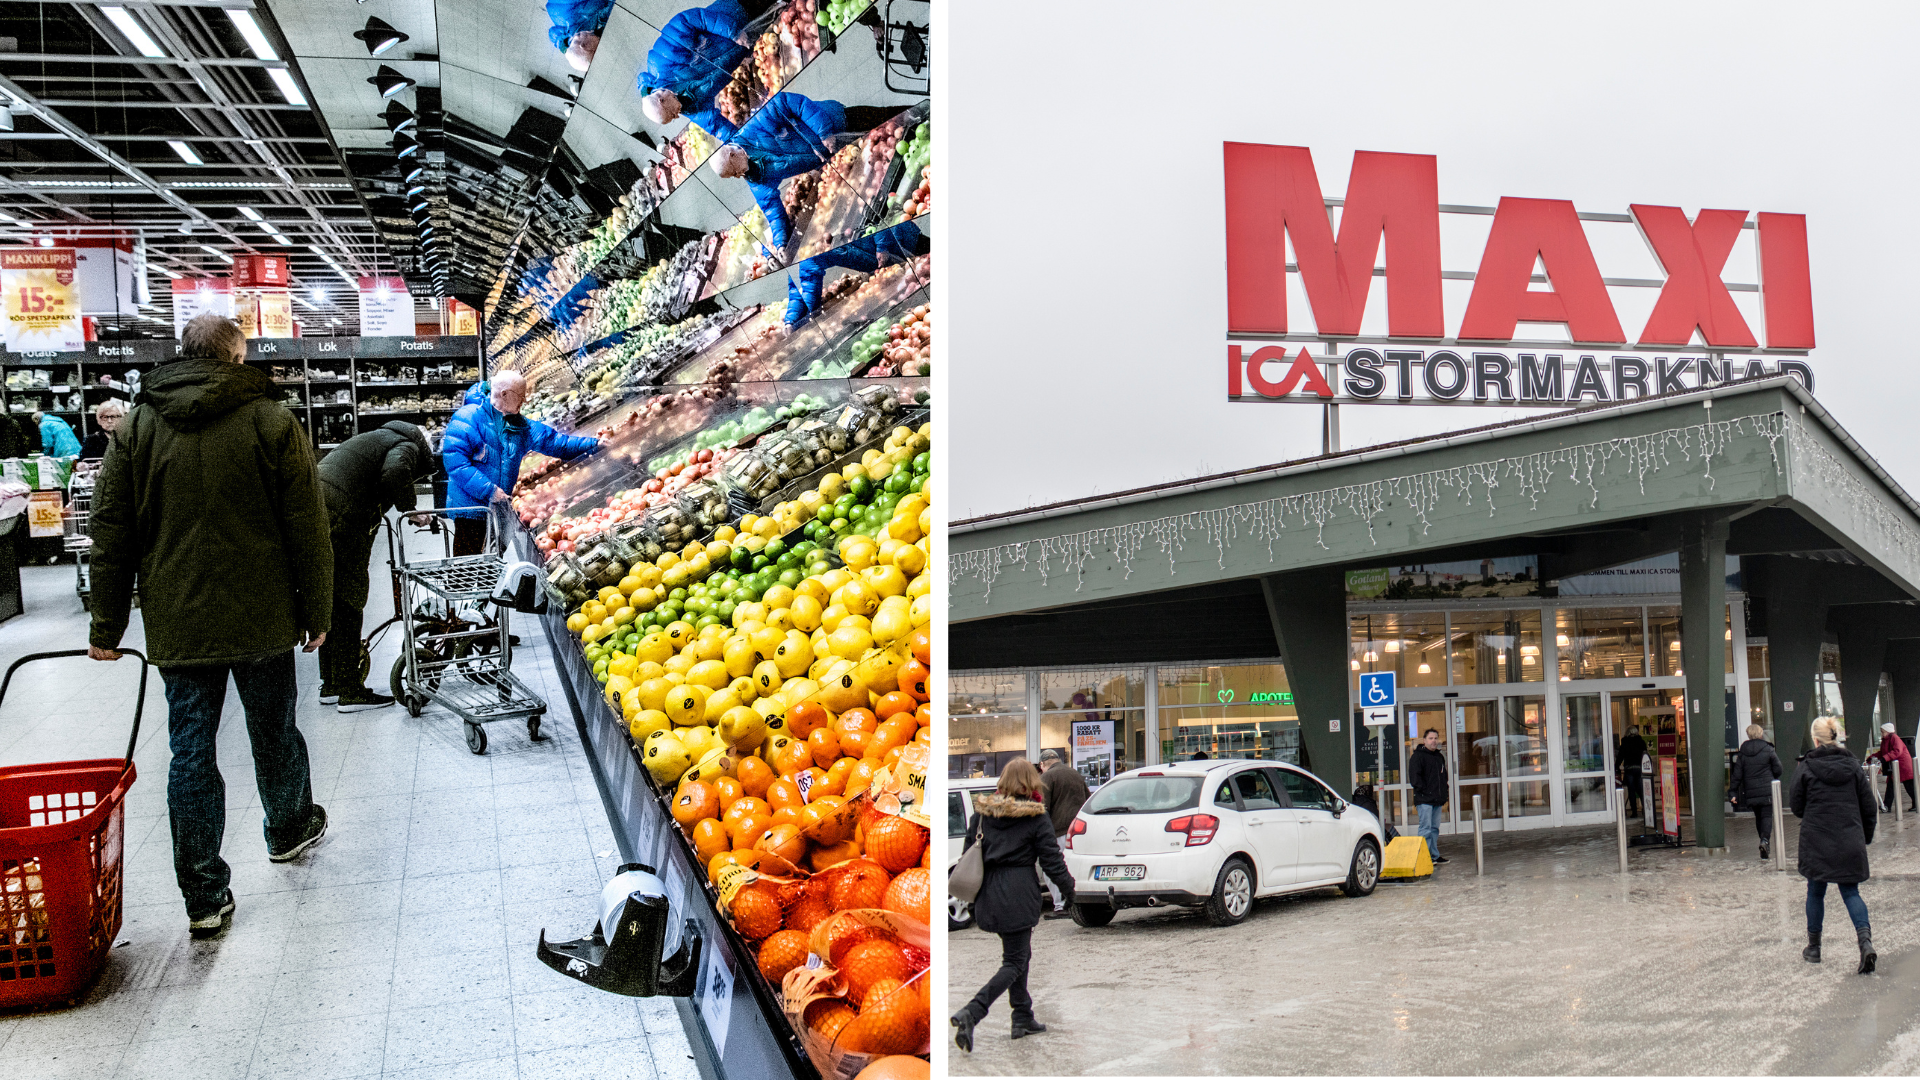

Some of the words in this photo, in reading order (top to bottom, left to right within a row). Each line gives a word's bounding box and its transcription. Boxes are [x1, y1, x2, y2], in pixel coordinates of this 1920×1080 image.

[1223, 141, 1816, 349] MAXI
[19, 287, 65, 313] 15:-
[98, 345, 135, 356] Potatis
[258, 342, 277, 353] Lök
[318, 341, 338, 352] Lök
[400, 341, 434, 351] Potatis
[1227, 345, 1334, 400] ICA
[1349, 571, 1387, 586] Gotland
[1100, 867, 1118, 877] ARP
[1124, 867, 1143, 877] 962
